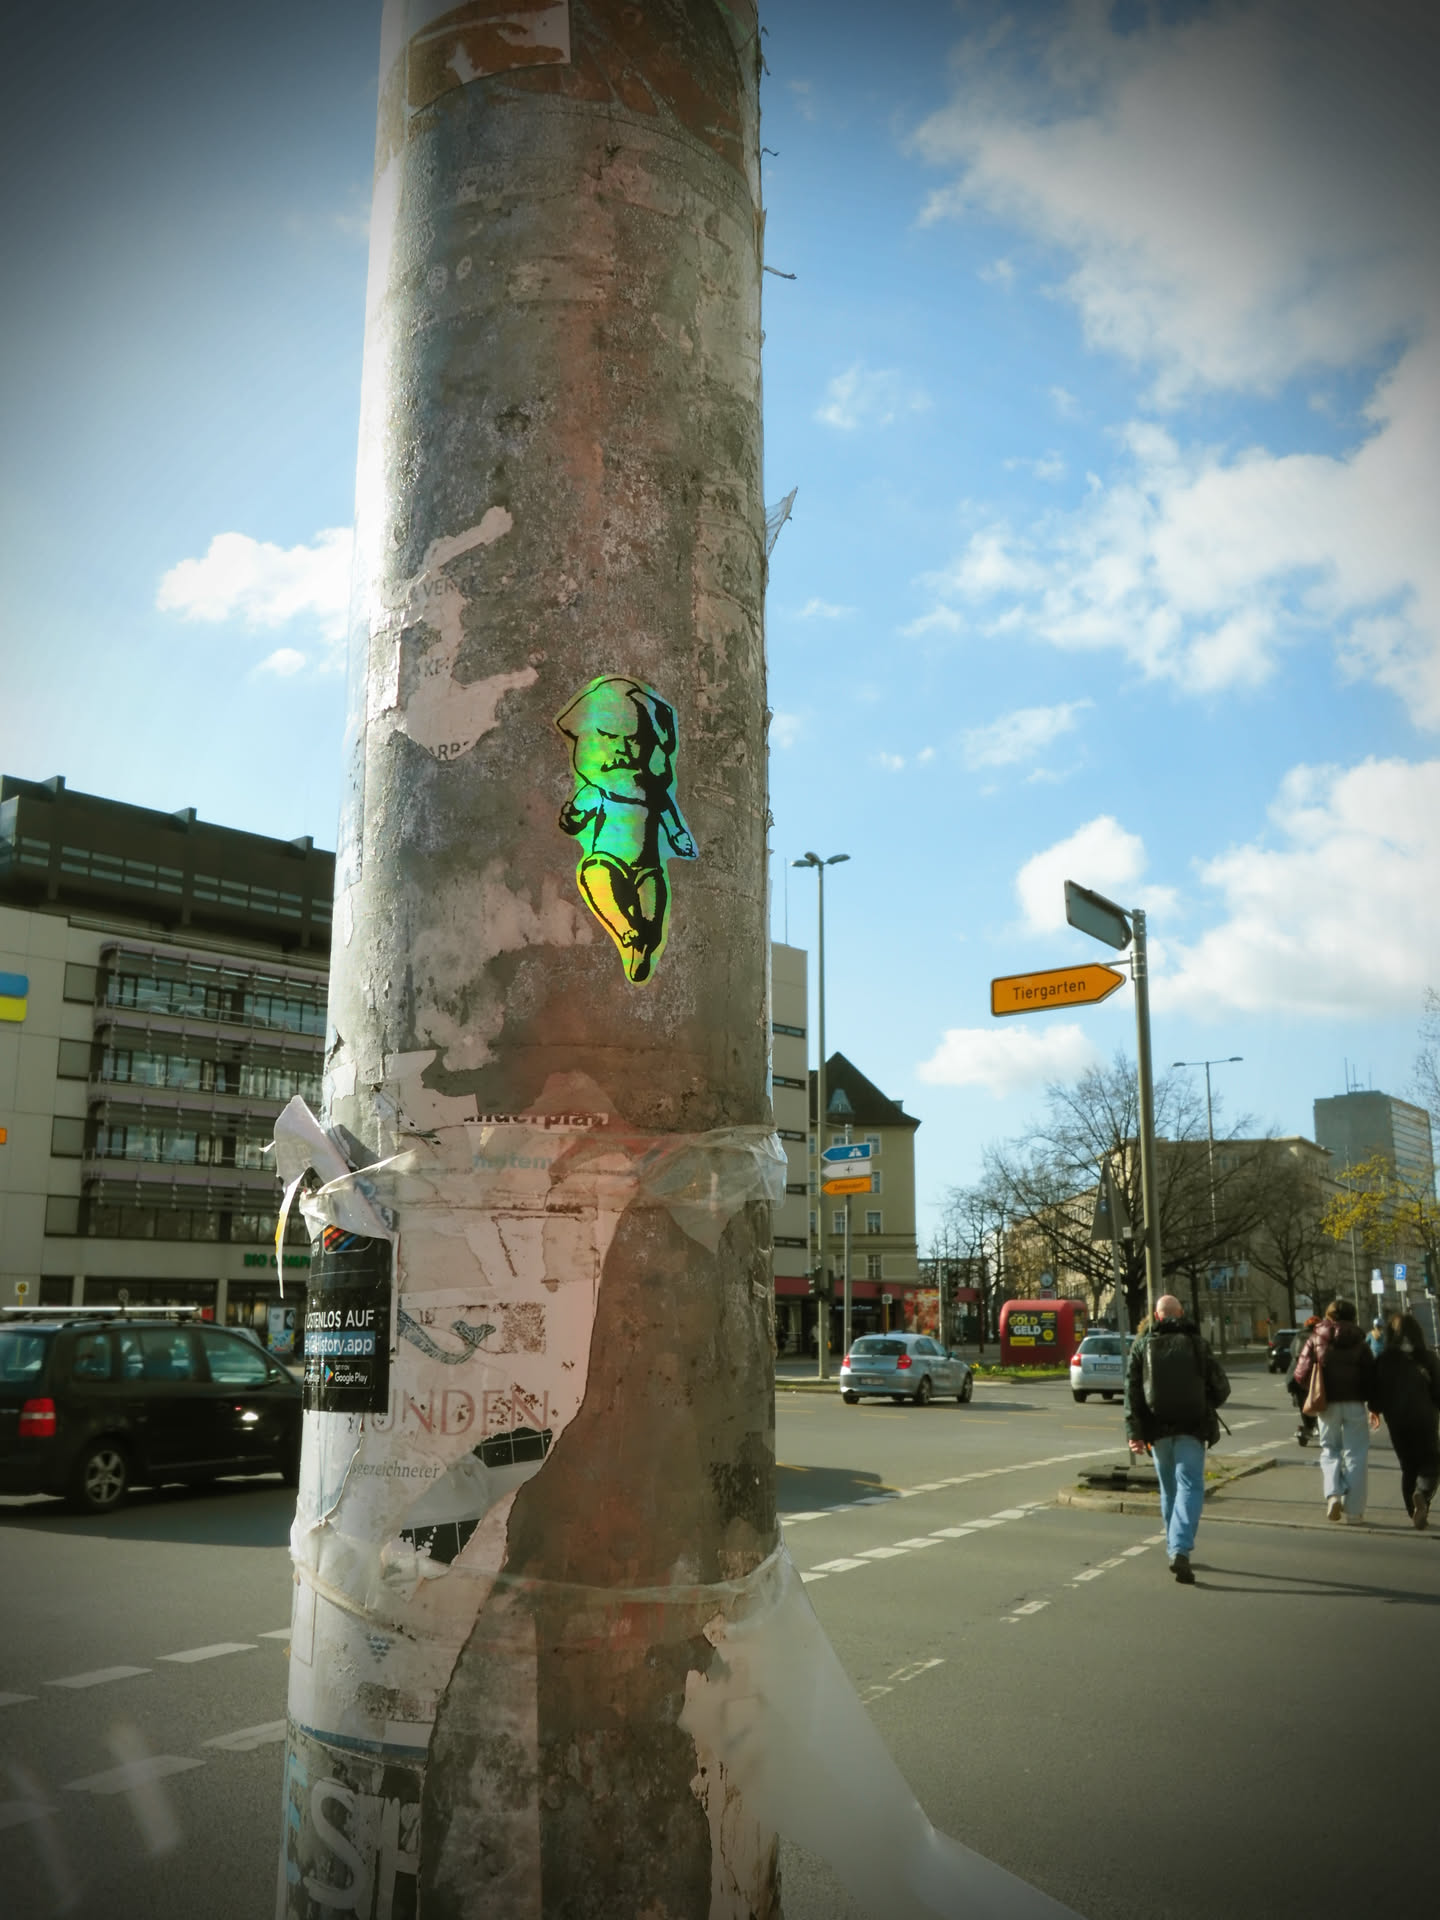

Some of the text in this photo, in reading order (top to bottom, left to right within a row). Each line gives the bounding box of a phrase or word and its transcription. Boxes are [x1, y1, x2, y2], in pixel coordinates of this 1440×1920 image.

[1012, 980, 1086, 1001] Tiergarten
[345, 1309, 375, 1328] AUF
[1009, 1316, 1038, 1325] GOLD
[1014, 1325, 1041, 1335] GELD
[334, 1371, 354, 1385] Google
[354, 1372, 368, 1385] Play
